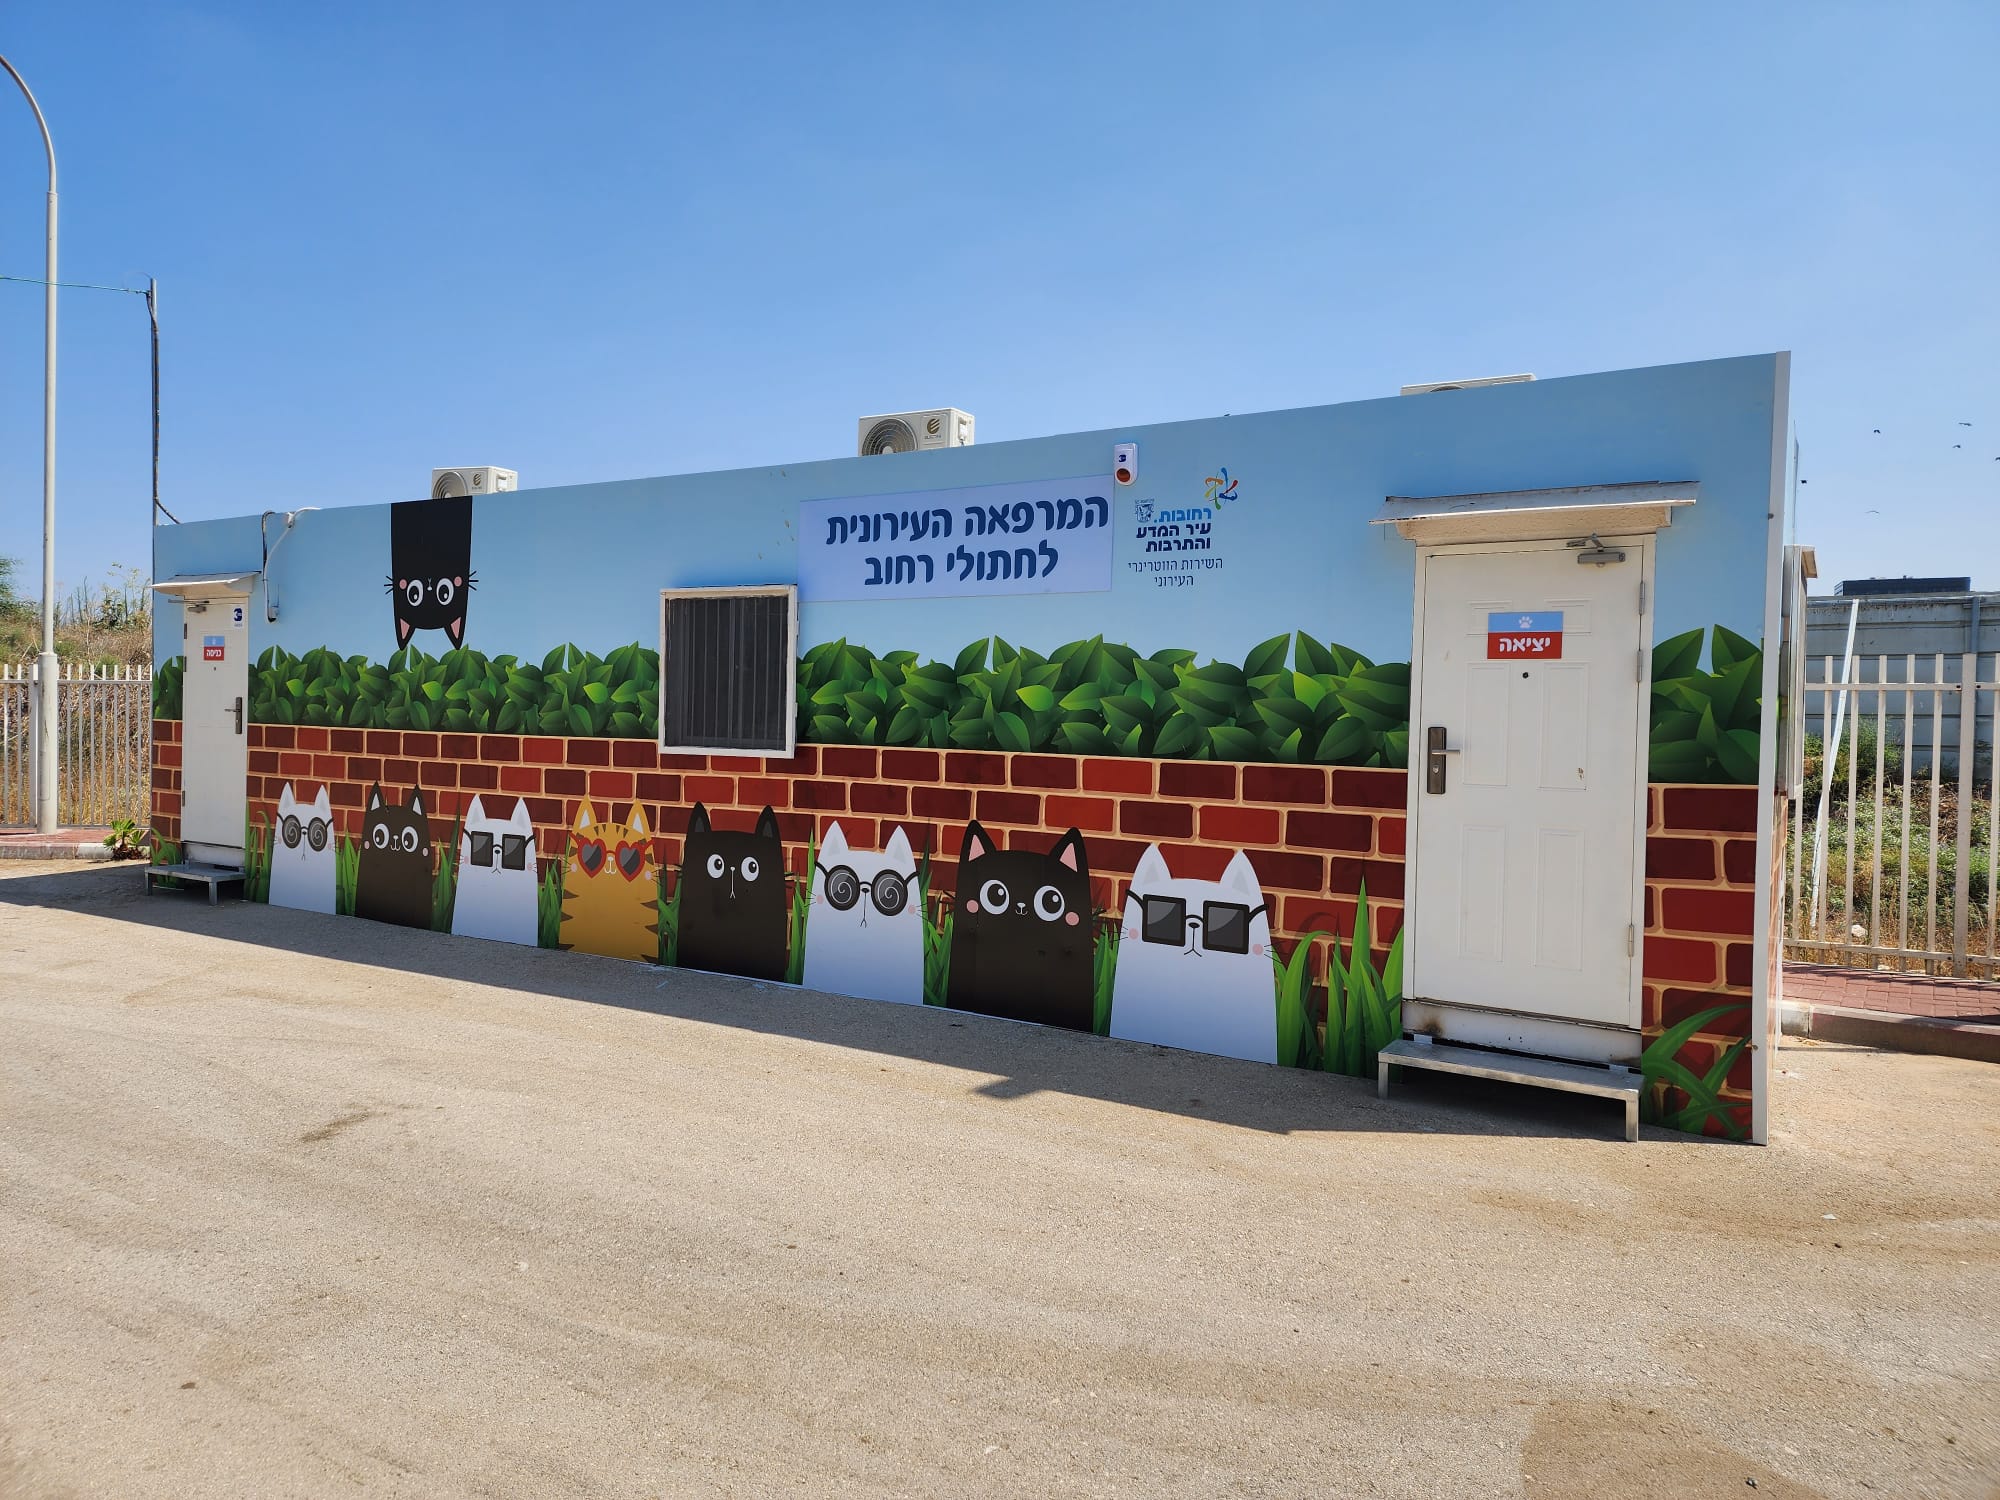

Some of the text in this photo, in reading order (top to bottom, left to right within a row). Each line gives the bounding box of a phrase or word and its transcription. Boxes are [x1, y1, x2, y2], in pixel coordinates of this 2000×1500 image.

[825, 496, 1109, 545] המרפאה העירונית
[1135, 522, 1212, 539] עיר המדע
[1145, 537, 1211, 553] והתרבות
[864, 539, 1059, 585] לחתולי רחוב
[1127, 557, 1223, 573] השירות הווטרינרי
[1154, 575, 1194, 587] העירוני
[1498, 636, 1551, 653] יציאה
